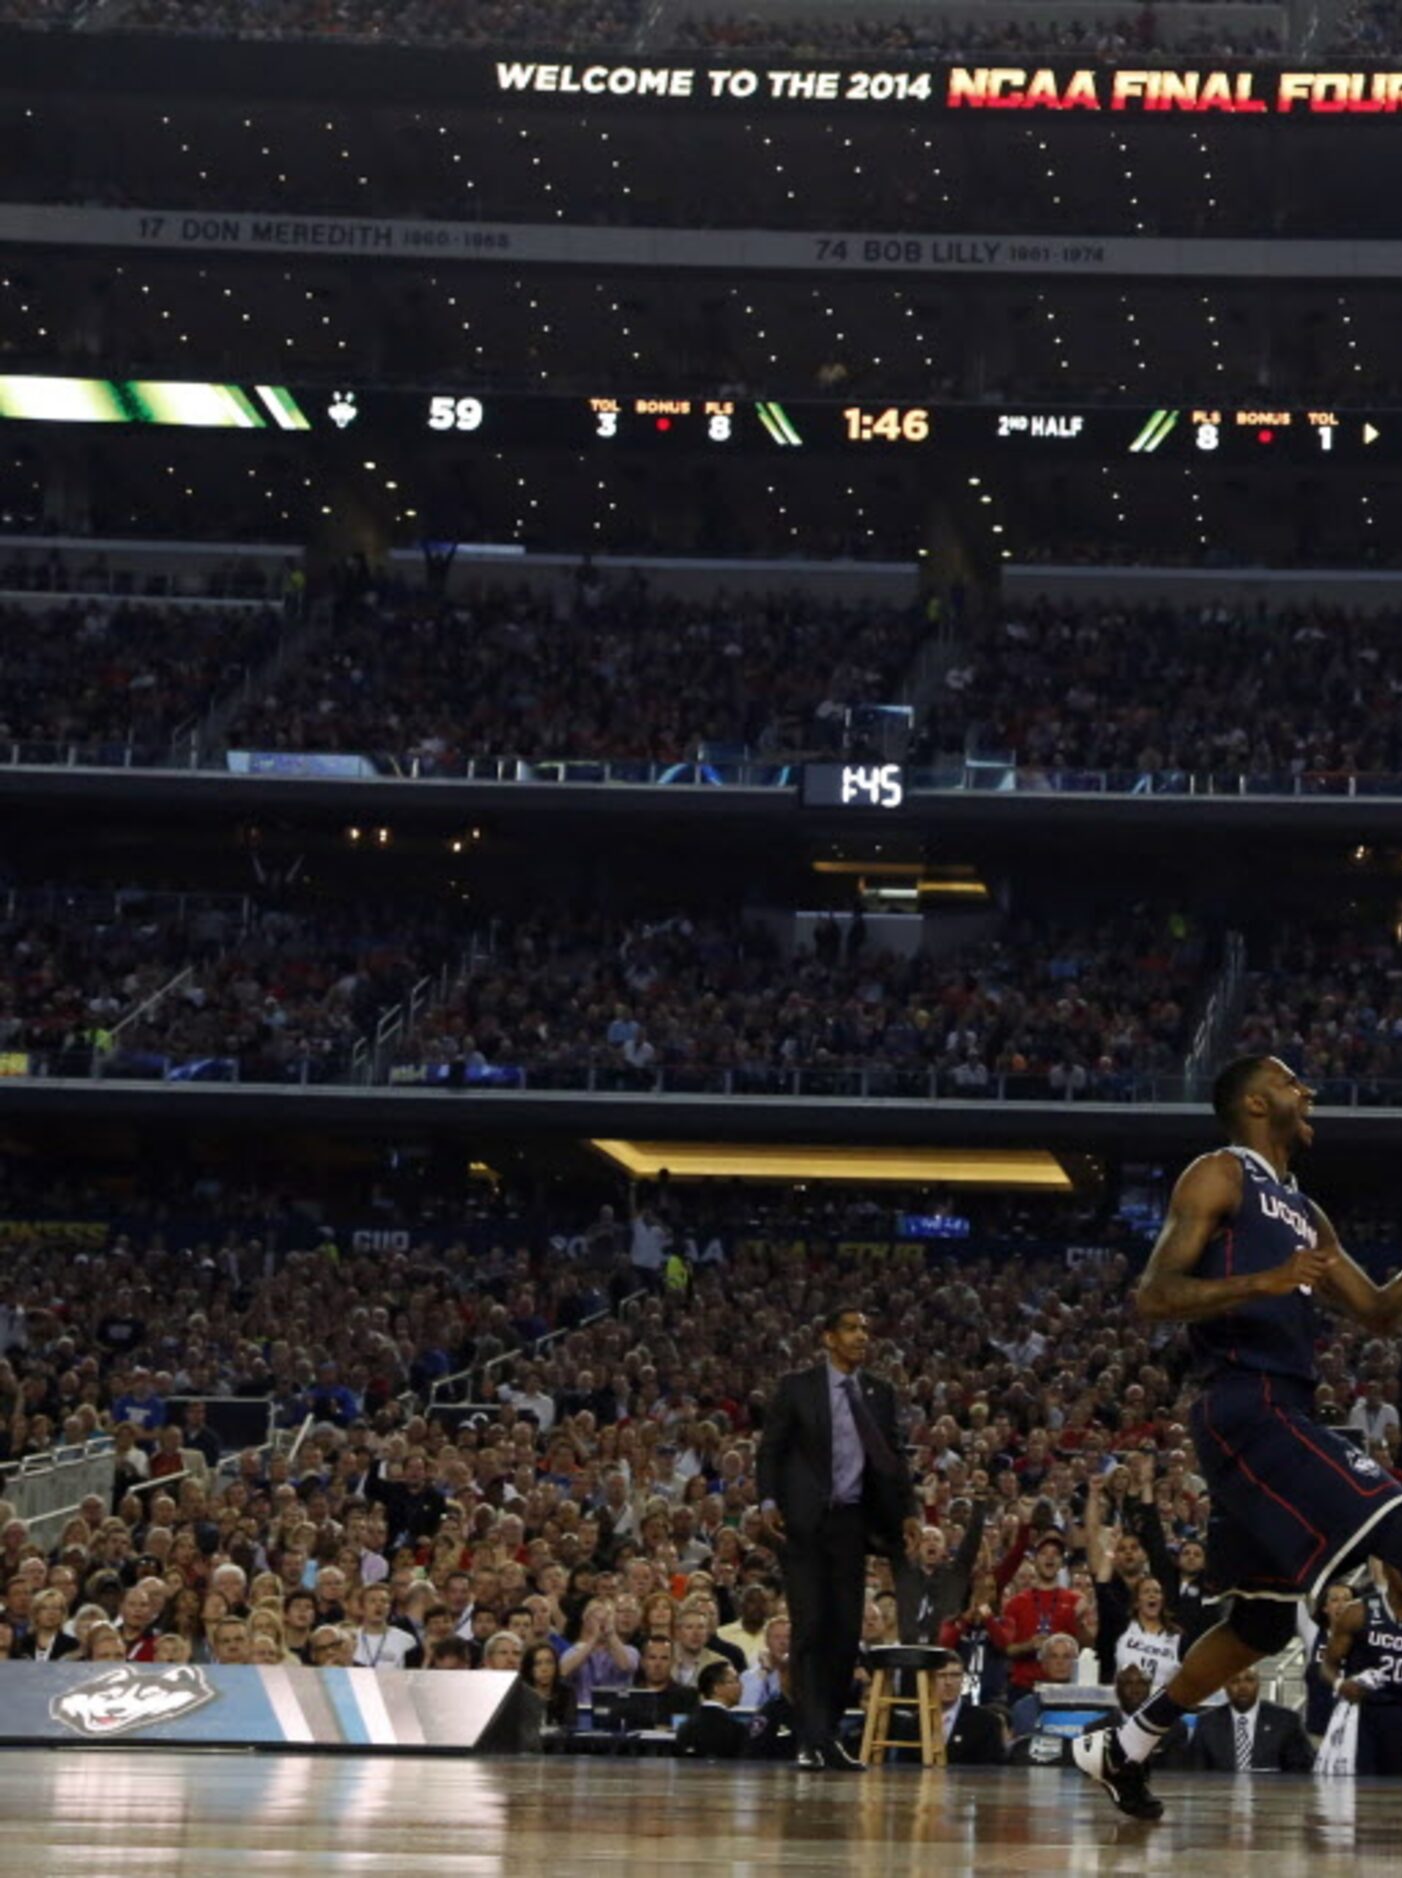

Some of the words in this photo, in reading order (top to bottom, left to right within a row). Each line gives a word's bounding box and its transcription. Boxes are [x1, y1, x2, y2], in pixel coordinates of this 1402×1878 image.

[497, 63, 694, 96] WELCOME
[708, 70, 758, 98] TO
[767, 72, 839, 98] THE
[845, 73, 931, 99] 2014
[948, 68, 1100, 112] NCAA
[1111, 71, 1267, 113] FINAL
[138, 218, 164, 238] 17
[181, 219, 241, 241] DON
[251, 221, 392, 248] MEREDITH
[815, 240, 847, 261] 74
[864, 241, 922, 262] BOB
[932, 242, 1001, 263] LILLY
[428, 397, 483, 431] 59
[590, 398, 620, 412] TOL
[635, 400, 690, 414] BONUS
[596, 412, 617, 437] 3
[708, 415, 731, 441] 8
[844, 407, 930, 441] 1:46
[1031, 416, 1084, 438] HALF
[1236, 412, 1291, 425] BONUS
[1308, 412, 1339, 426] TOL
[1196, 424, 1219, 450] 8
[1318, 426, 1331, 451] 1
[842, 763, 902, 808] 1:45
